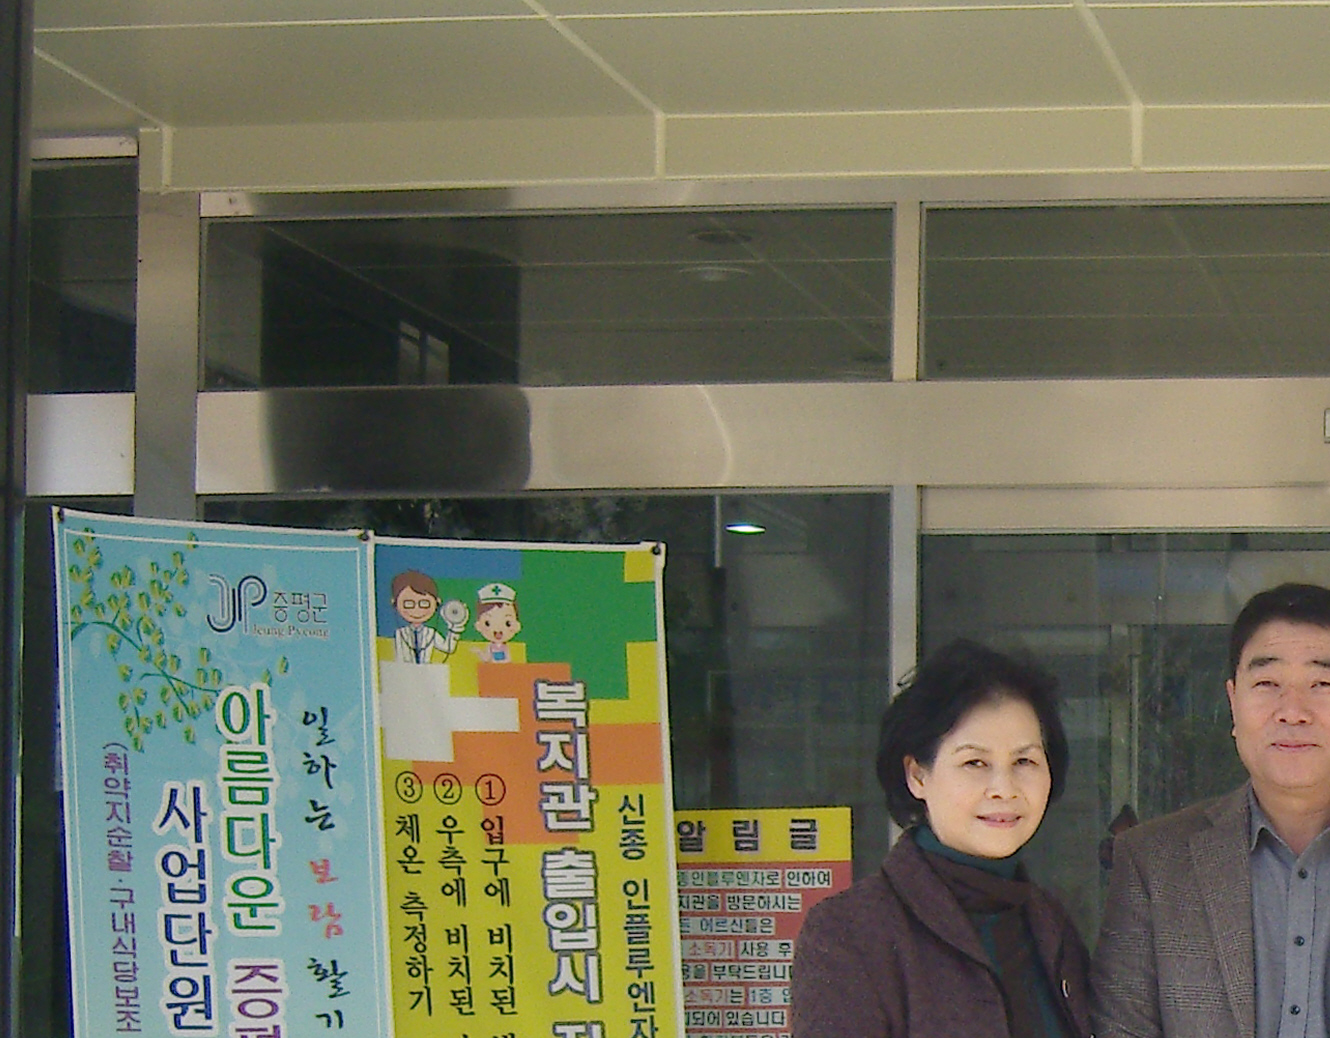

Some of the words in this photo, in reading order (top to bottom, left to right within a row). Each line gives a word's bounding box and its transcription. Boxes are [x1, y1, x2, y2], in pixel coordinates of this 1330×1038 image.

[273, 591, 328, 624] 증평군
[302, 706, 338, 831] 일하는
[533, 678, 598, 834] 복지관
[220, 688, 279, 931] 아름다운
[618, 792, 648, 862] 신종
[158, 785, 214, 1032] 사업단원
[308, 859, 344, 938] 보람
[727, 893, 801, 911] 방문하시는
[787, 870, 831, 887] 인하여
[400, 890, 434, 1017] 측정하기
[541, 846, 603, 1004] 출입시
[700, 917, 773, 934] 어르신들은
[740, 941, 769, 957] 사용
[447, 922, 476, 1016] 비치된
[487, 923, 518, 1015] 비치된
[713, 963, 793, 980] 부탁드립니
[725, 1010, 785, 1027] 있습니다
